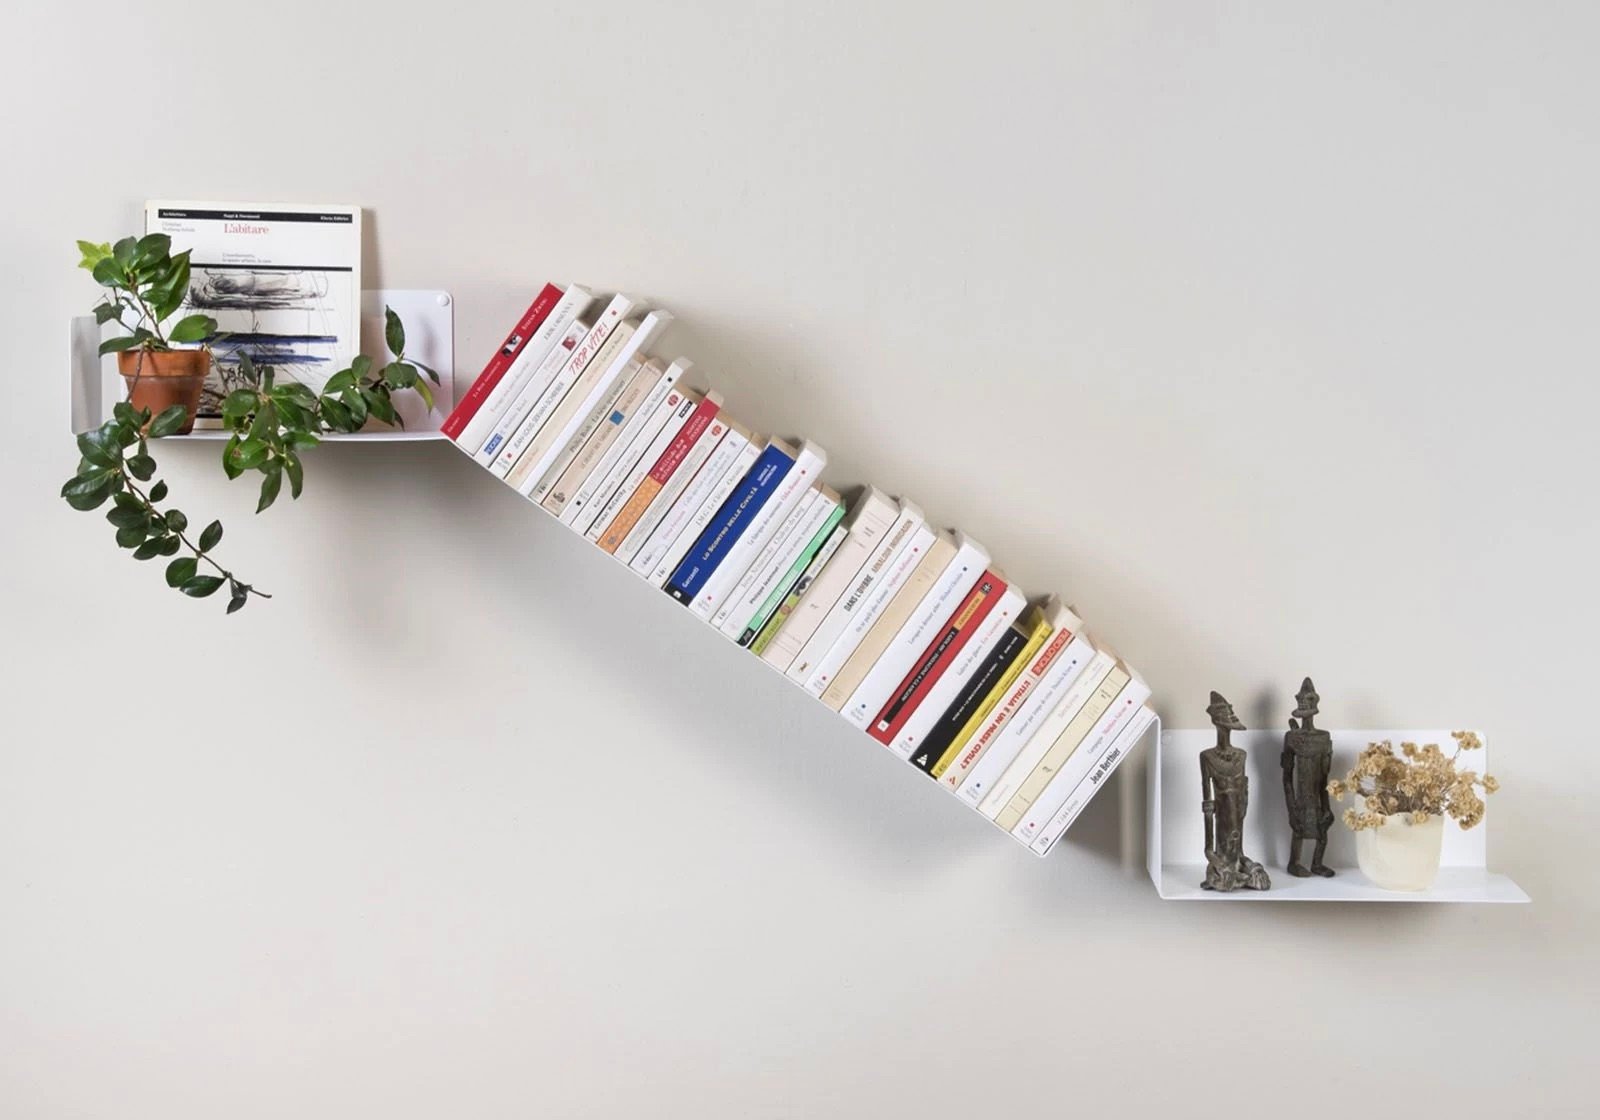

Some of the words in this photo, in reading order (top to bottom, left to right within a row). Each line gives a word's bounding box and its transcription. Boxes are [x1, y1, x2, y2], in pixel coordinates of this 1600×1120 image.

[224, 223, 270, 235] L'abitare
[567, 346, 592, 374] TROP
[593, 509, 611, 530] Cormac
[606, 486, 628, 512] McCarthy
[706, 524, 730, 553] SCONTRO
[725, 507, 743, 527] DELLE
[737, 484, 759, 509] CIVILTÀ
[680, 565, 700, 589] Garzanti
[748, 584, 766, 606] Philippe
[842, 595, 859, 612] DANS
[852, 572, 875, 599] L'OMBRE
[1007, 678, 1032, 708] L'ITALIA
[994, 710, 1007, 725] UN
[978, 721, 999, 745] PAESE
[958, 741, 983, 770] CIVILE?
[1087, 767, 1105, 785] Jean
[1098, 745, 1122, 772] Berthier
